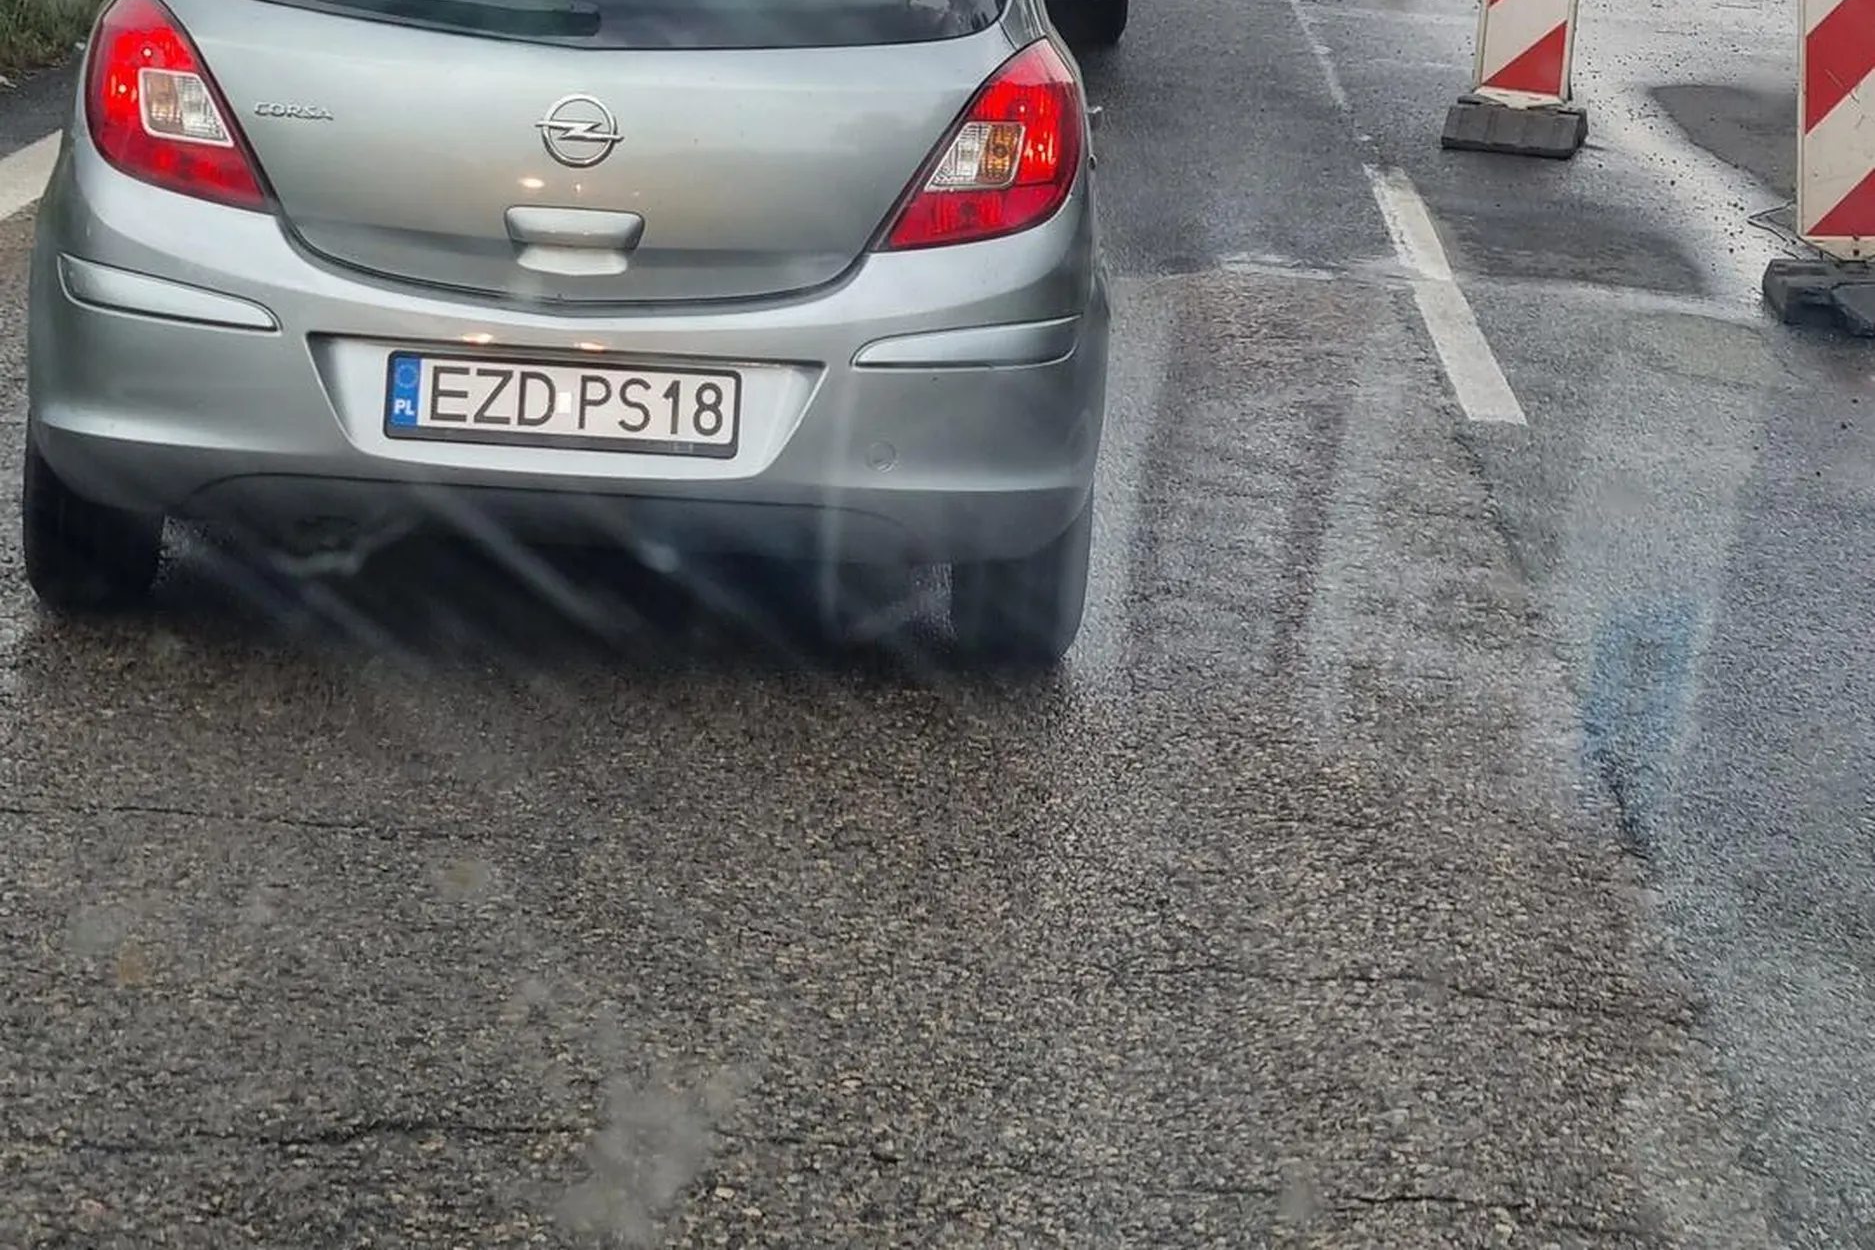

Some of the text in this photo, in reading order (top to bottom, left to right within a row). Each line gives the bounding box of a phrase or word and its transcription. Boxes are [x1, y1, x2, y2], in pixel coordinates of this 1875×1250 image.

[254, 100, 334, 121] CORSA
[394, 399, 416, 417] PL
[429, 365, 724, 437] EZD PS18
